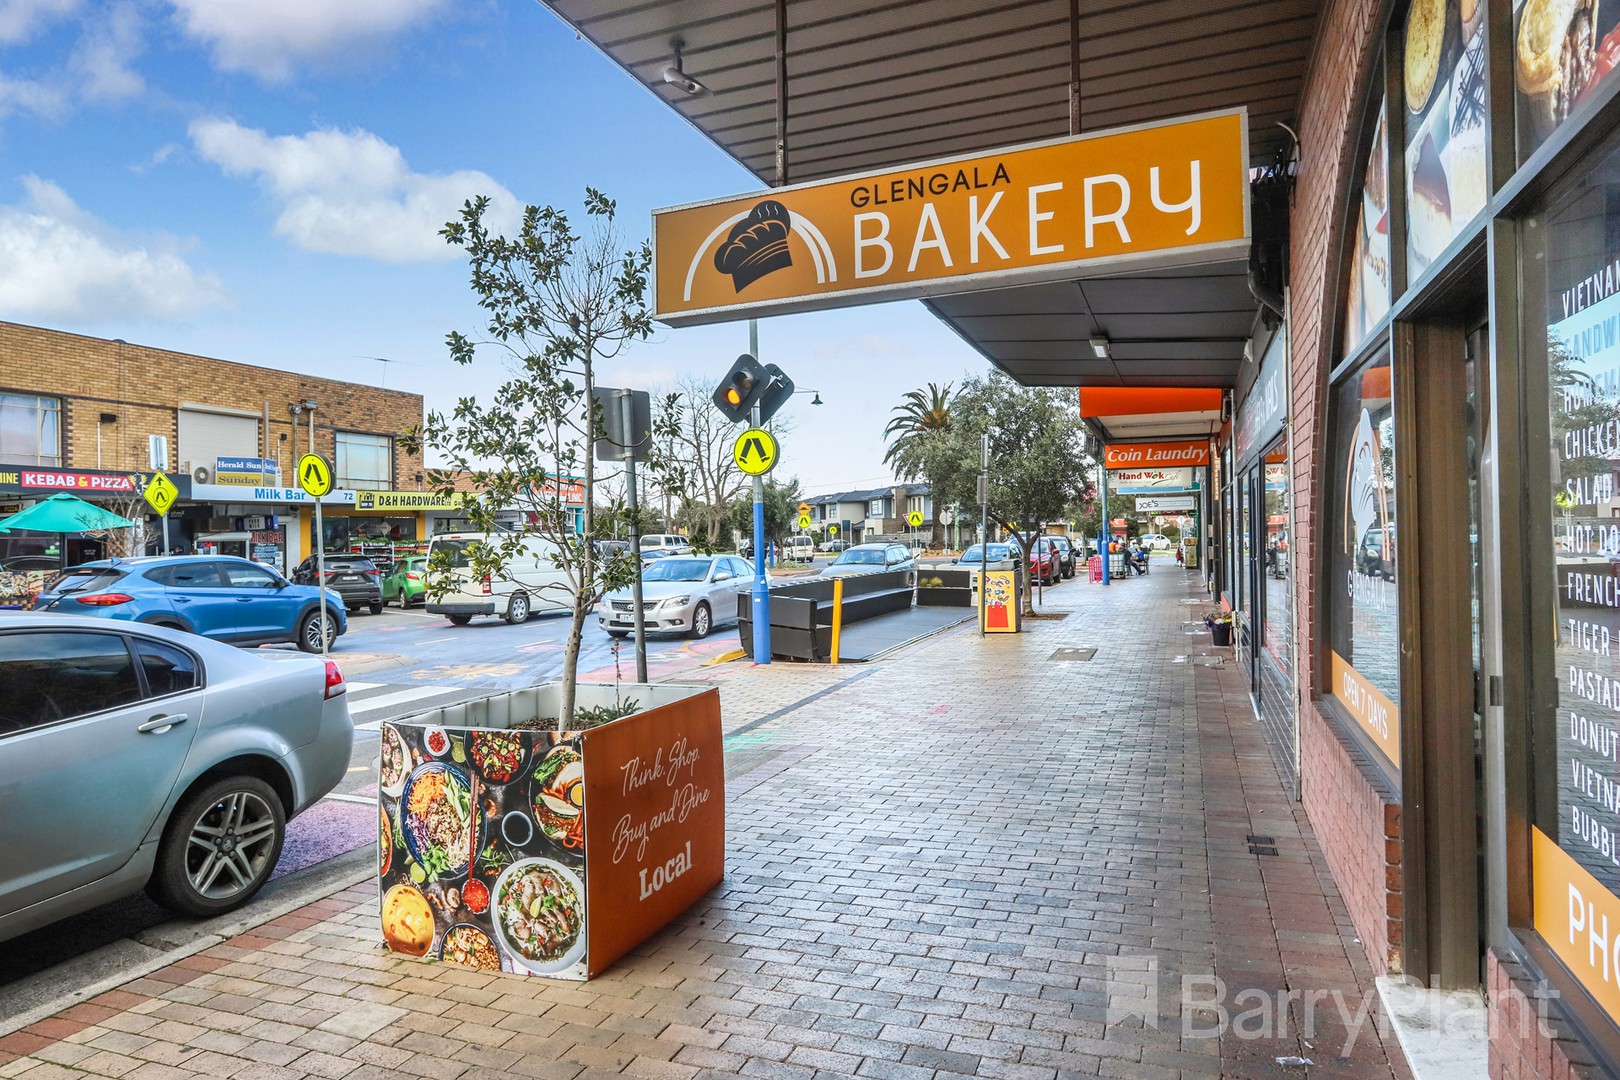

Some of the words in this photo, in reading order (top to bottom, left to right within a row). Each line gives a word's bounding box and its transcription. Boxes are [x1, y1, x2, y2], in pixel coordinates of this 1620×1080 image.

[850, 162, 1011, 208] GLENGALA
[853, 159, 1201, 280] BAKERY
[1108, 448, 1142, 462] Coin
[1146, 445, 1208, 463] Laundry
[25, 473, 76, 487] KEBAB
[78, 476, 89, 487] &
[91, 477, 131, 489] PIZZA
[218, 475, 261, 486] Sunday
[1118, 472, 1142, 480] Hand
[1144, 472, 1165, 480] Wok
[1566, 473, 1612, 507] SALAD
[255, 488, 281, 500] Milk
[286, 489, 306, 500] Bar
[379, 495, 398, 506] D&H
[400, 495, 445, 506] HARDWARE
[268, 531, 284, 543] BAR
[1566, 525, 1592, 554] HOT
[1568, 618, 1610, 657] TIGER
[1343, 671, 1360, 710] OPEN
[1361, 687, 1366, 715] 7
[1367, 694, 1388, 741] DAYS
[620, 747, 666, 797] Think.
[667, 736, 700, 787] Shop.
[612, 813, 649, 865] Buy
[650, 789, 679, 832] and
[678, 783, 711, 824] Dine
[1572, 805, 1620, 866] BUBBL
[639, 840, 692, 902] Local
